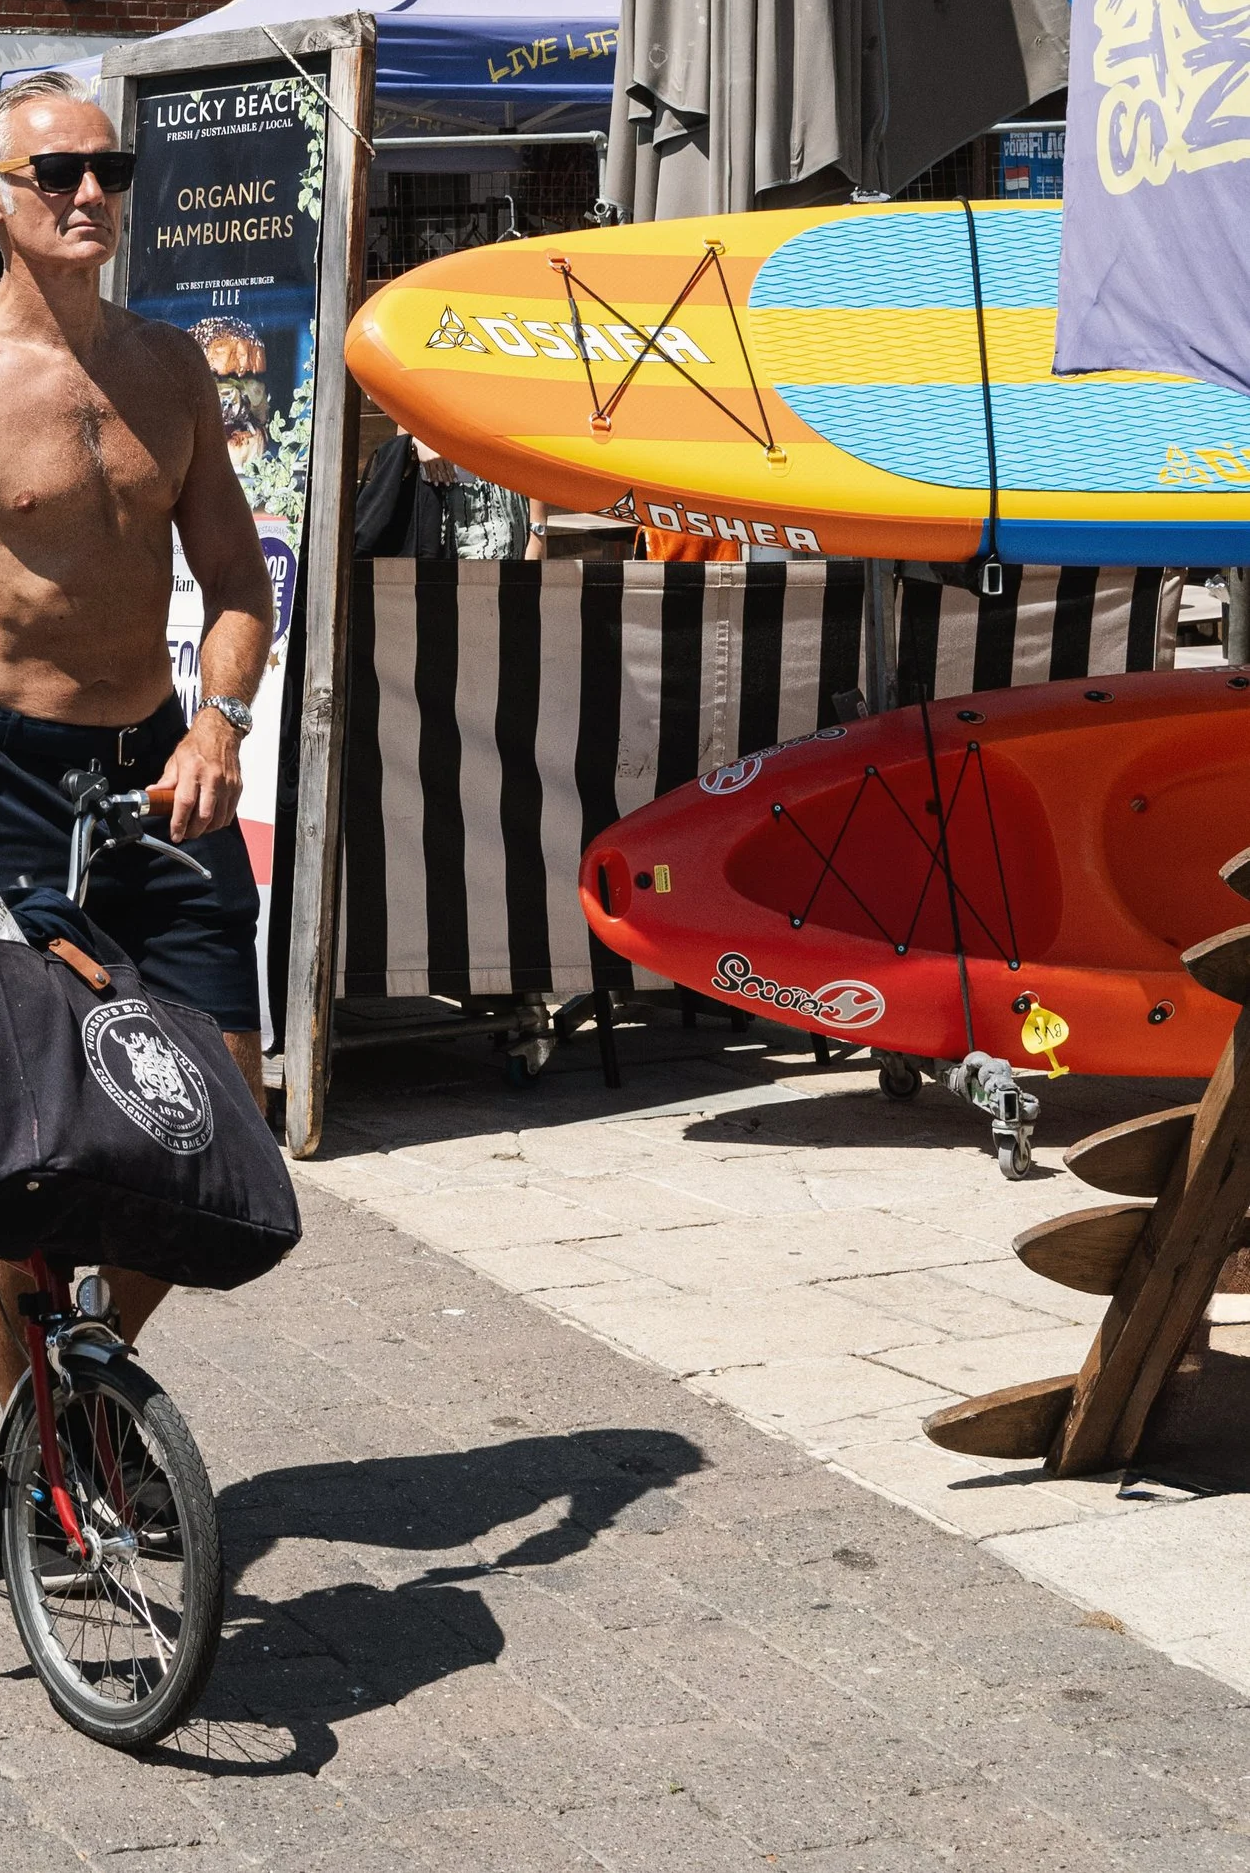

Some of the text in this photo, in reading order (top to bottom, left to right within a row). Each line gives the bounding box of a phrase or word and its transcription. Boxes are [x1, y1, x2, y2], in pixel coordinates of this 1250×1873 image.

[488, 29, 621, 83] LIVE LIF
[157, 98, 226, 128] LUCKY
[166, 130, 193, 142] FRESH
[201, 122, 258, 138] SUSTAINABLE
[265, 118, 294, 130] LOCAL
[177, 180, 276, 211] ORGANIC
[157, 214, 294, 249] HAMBURGERS
[176, 276, 275, 291] UK'S BEST EVER ORGANIC BURGER
[212, 289, 240, 306] ELLE
[86, 1004, 148, 1050] HUDSON'S BAY
[96, 1068, 202, 1149] COMPAGNIE DE LA BAIE
[158, 1104, 185, 1120] 1670
